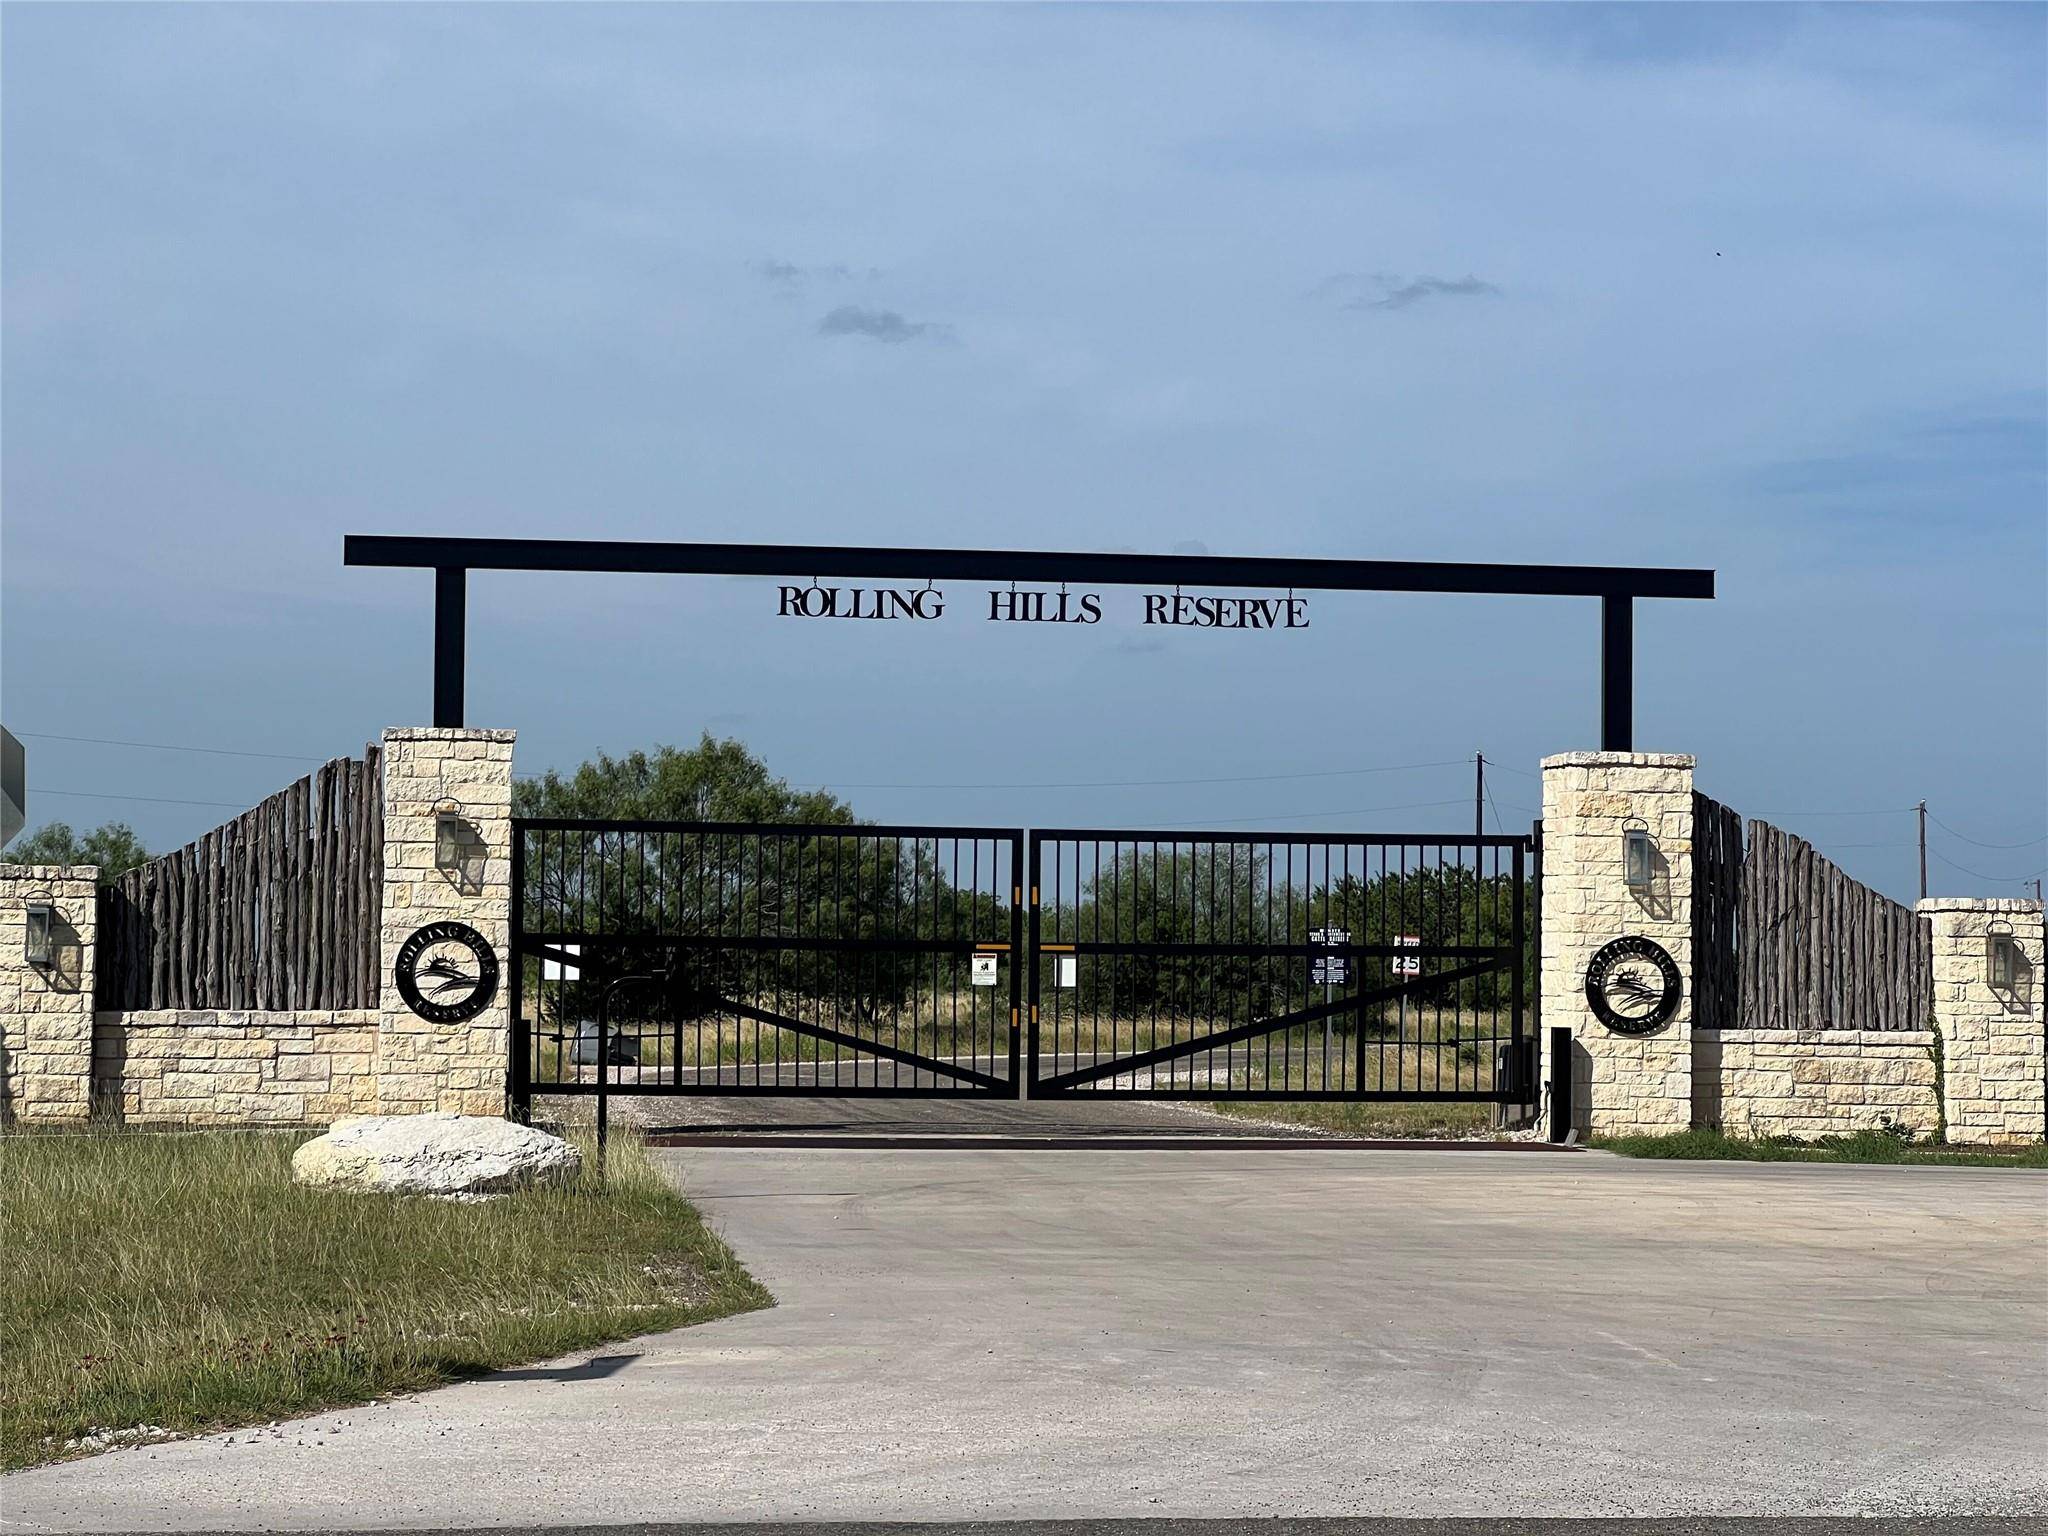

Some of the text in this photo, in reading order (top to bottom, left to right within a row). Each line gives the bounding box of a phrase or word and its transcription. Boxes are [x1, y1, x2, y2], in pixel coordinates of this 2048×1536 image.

[776, 586, 1311, 629] ROLLING HILLS RESERVE
[401, 926, 496, 975] ROLLING HILLS
[1395, 956, 1419, 970] 25
[1588, 941, 1678, 988] ROLLING HILLS
[1602, 1012, 1665, 1030] RESERVE
